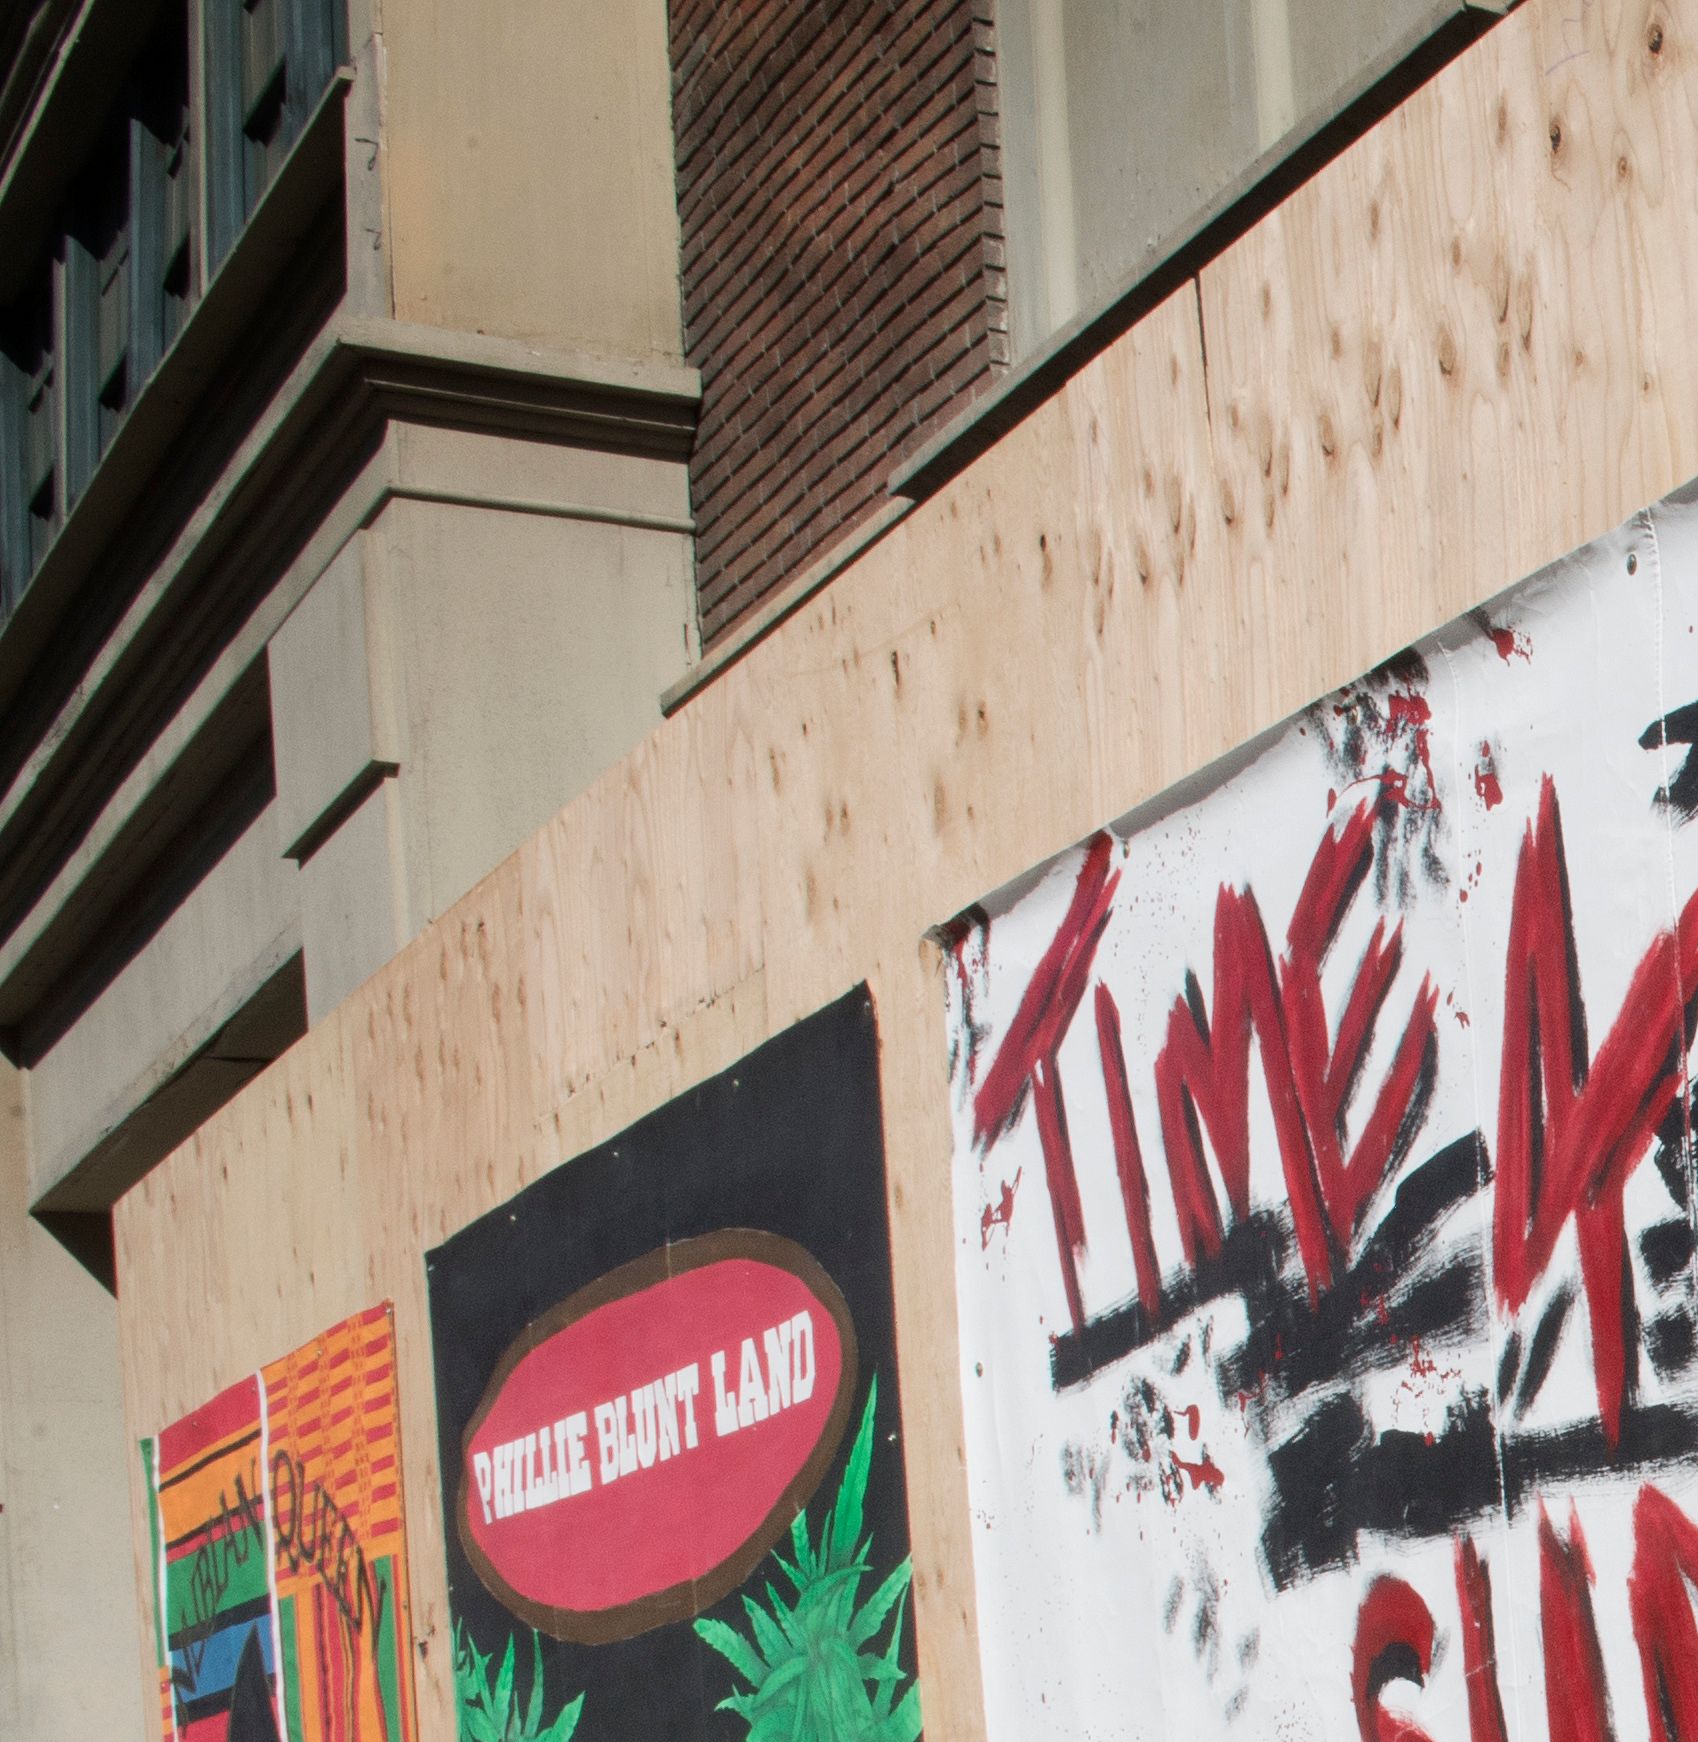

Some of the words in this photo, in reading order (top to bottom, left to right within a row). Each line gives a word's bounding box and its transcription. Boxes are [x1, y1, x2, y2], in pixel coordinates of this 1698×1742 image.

[969, 796, 1441, 1338] TIME
[472, 1410, 593, 1525] PHILLIE
[594, 1362, 700, 1486] BLUNT
[711, 1309, 817, 1437] LAND
[271, 1448, 387, 1658] QUEEN
